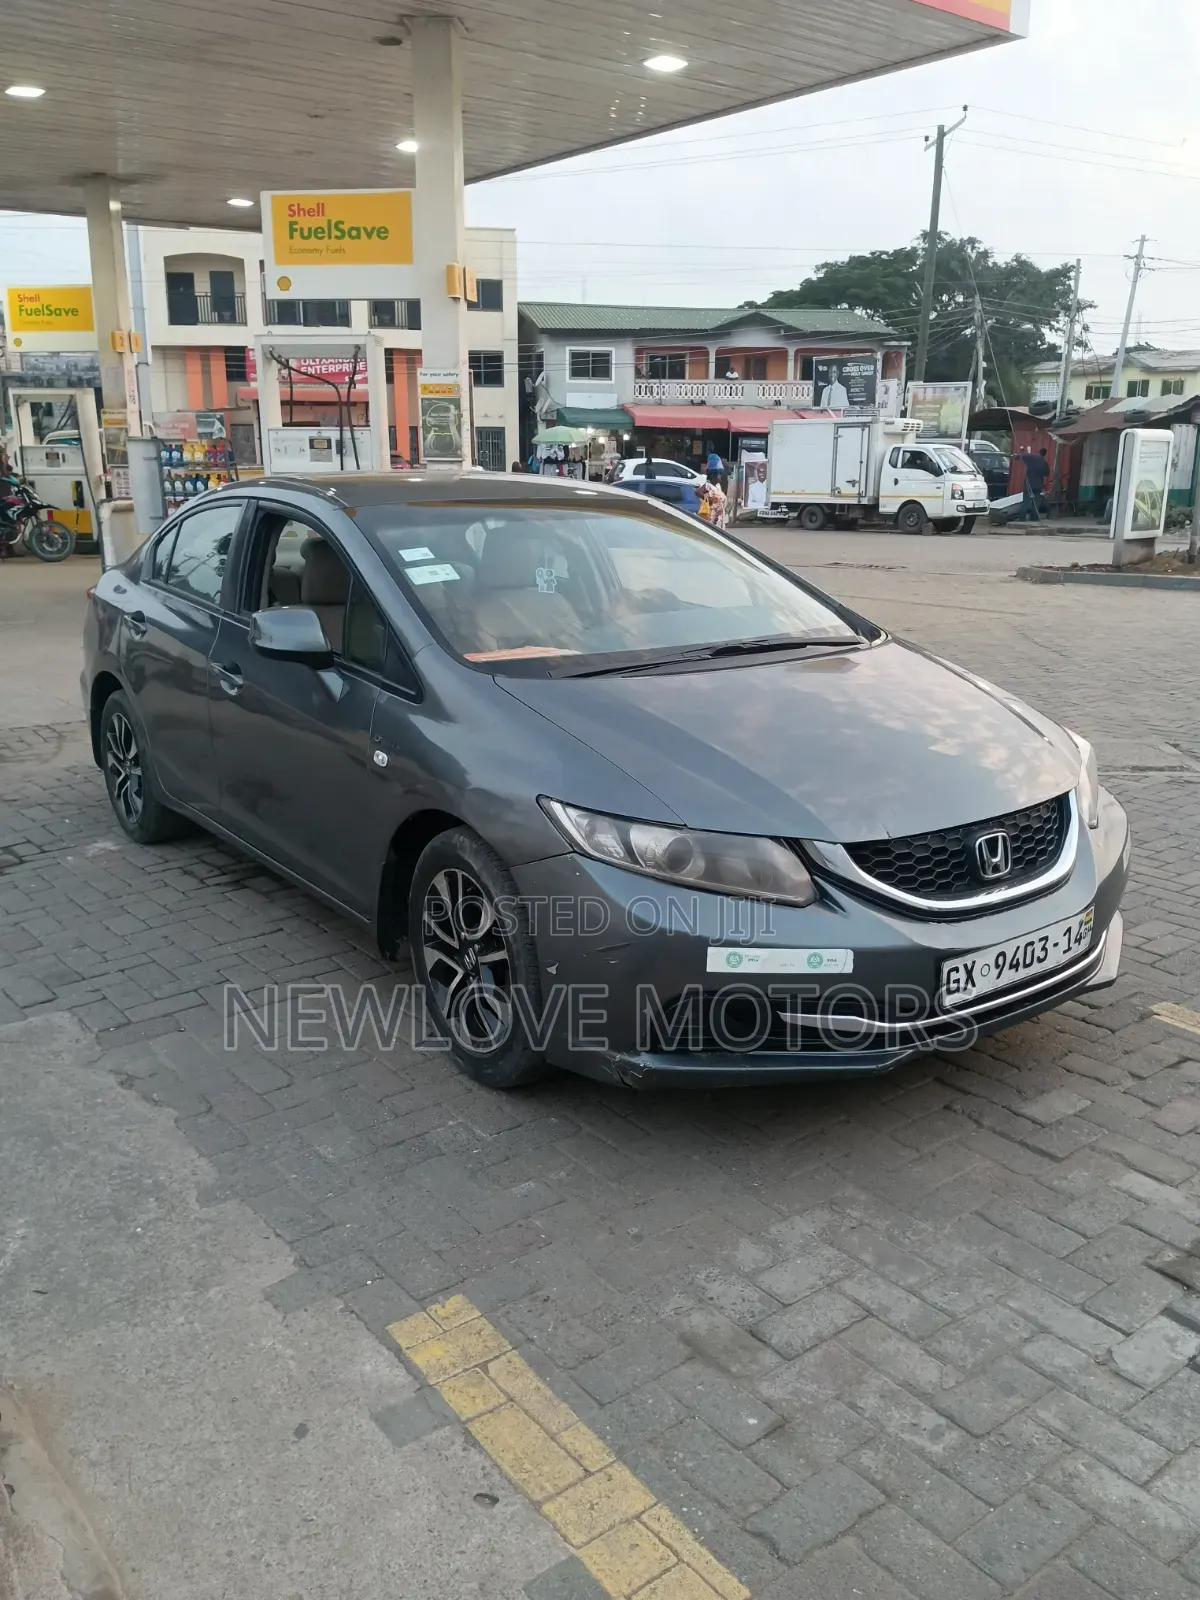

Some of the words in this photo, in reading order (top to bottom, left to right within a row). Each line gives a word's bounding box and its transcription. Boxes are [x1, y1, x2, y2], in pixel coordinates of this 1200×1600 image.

[287, 202, 325, 218] Shell
[288, 219, 390, 241] FuelSave
[288, 245, 324, 257] Economy
[326, 245, 346, 255] Fuels
[17, 293, 41, 303] Shell
[18, 303, 79, 317] FuelSave
[842, 365, 860, 373] CROSS
[859, 364, 875, 372] OVER
[946, 960, 977, 996] GX
[994, 919, 1084, 980] 9403-14
